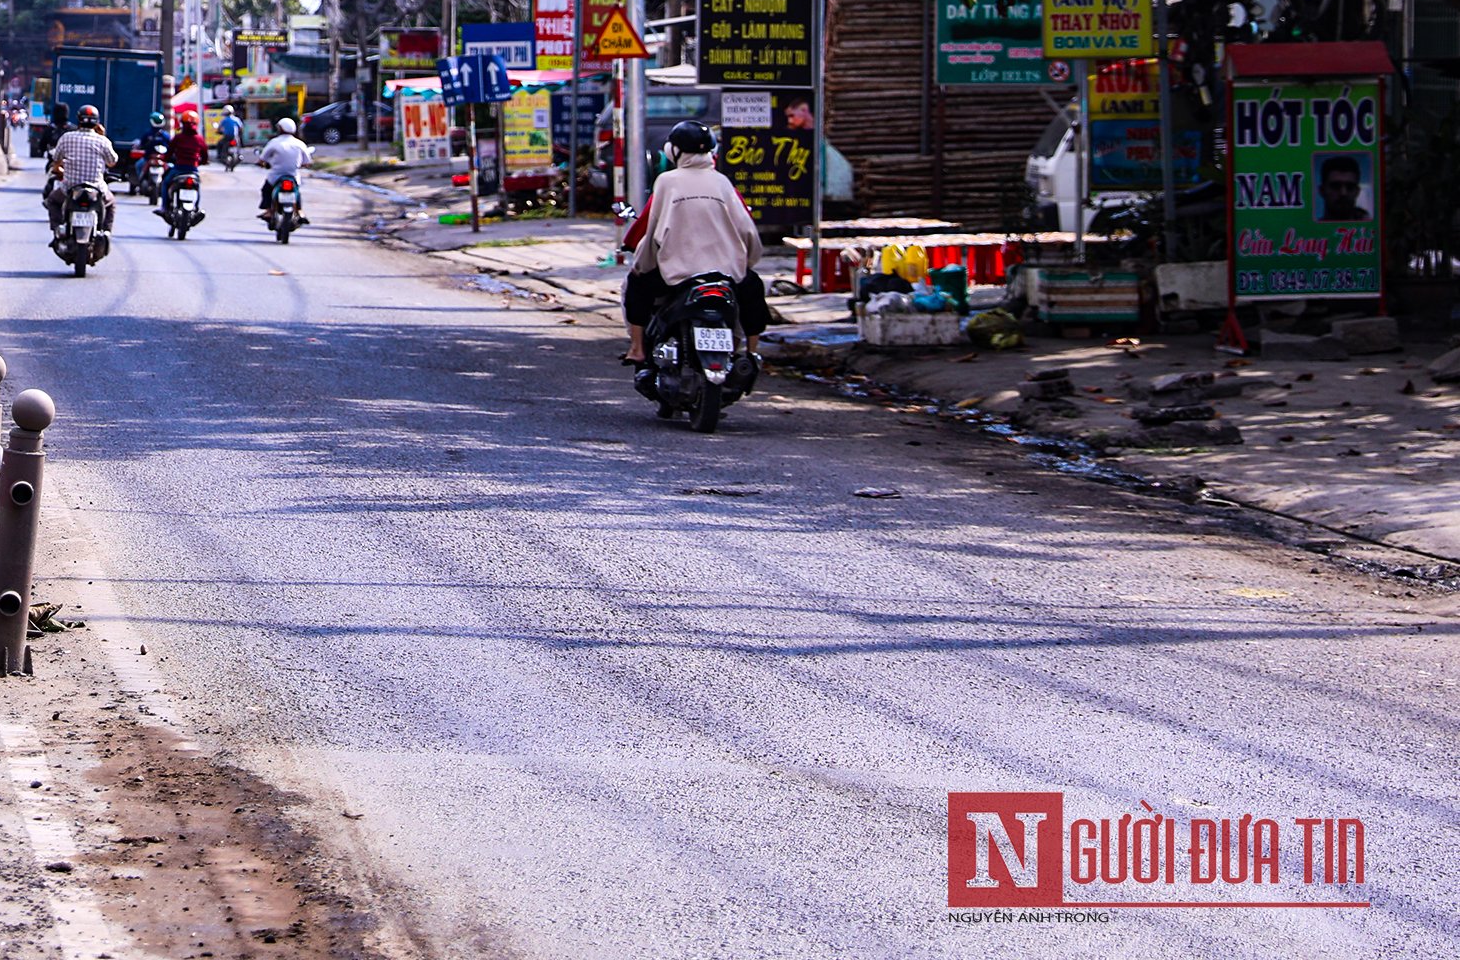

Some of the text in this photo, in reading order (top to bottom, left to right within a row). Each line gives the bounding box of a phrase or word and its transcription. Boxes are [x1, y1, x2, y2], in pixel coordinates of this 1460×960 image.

[1050, 13, 1093, 31] THAY
[1118, 36, 1139, 48] XE
[1310, 85, 1376, 146] TÓC
[1235, 172, 1304, 209] NAM
